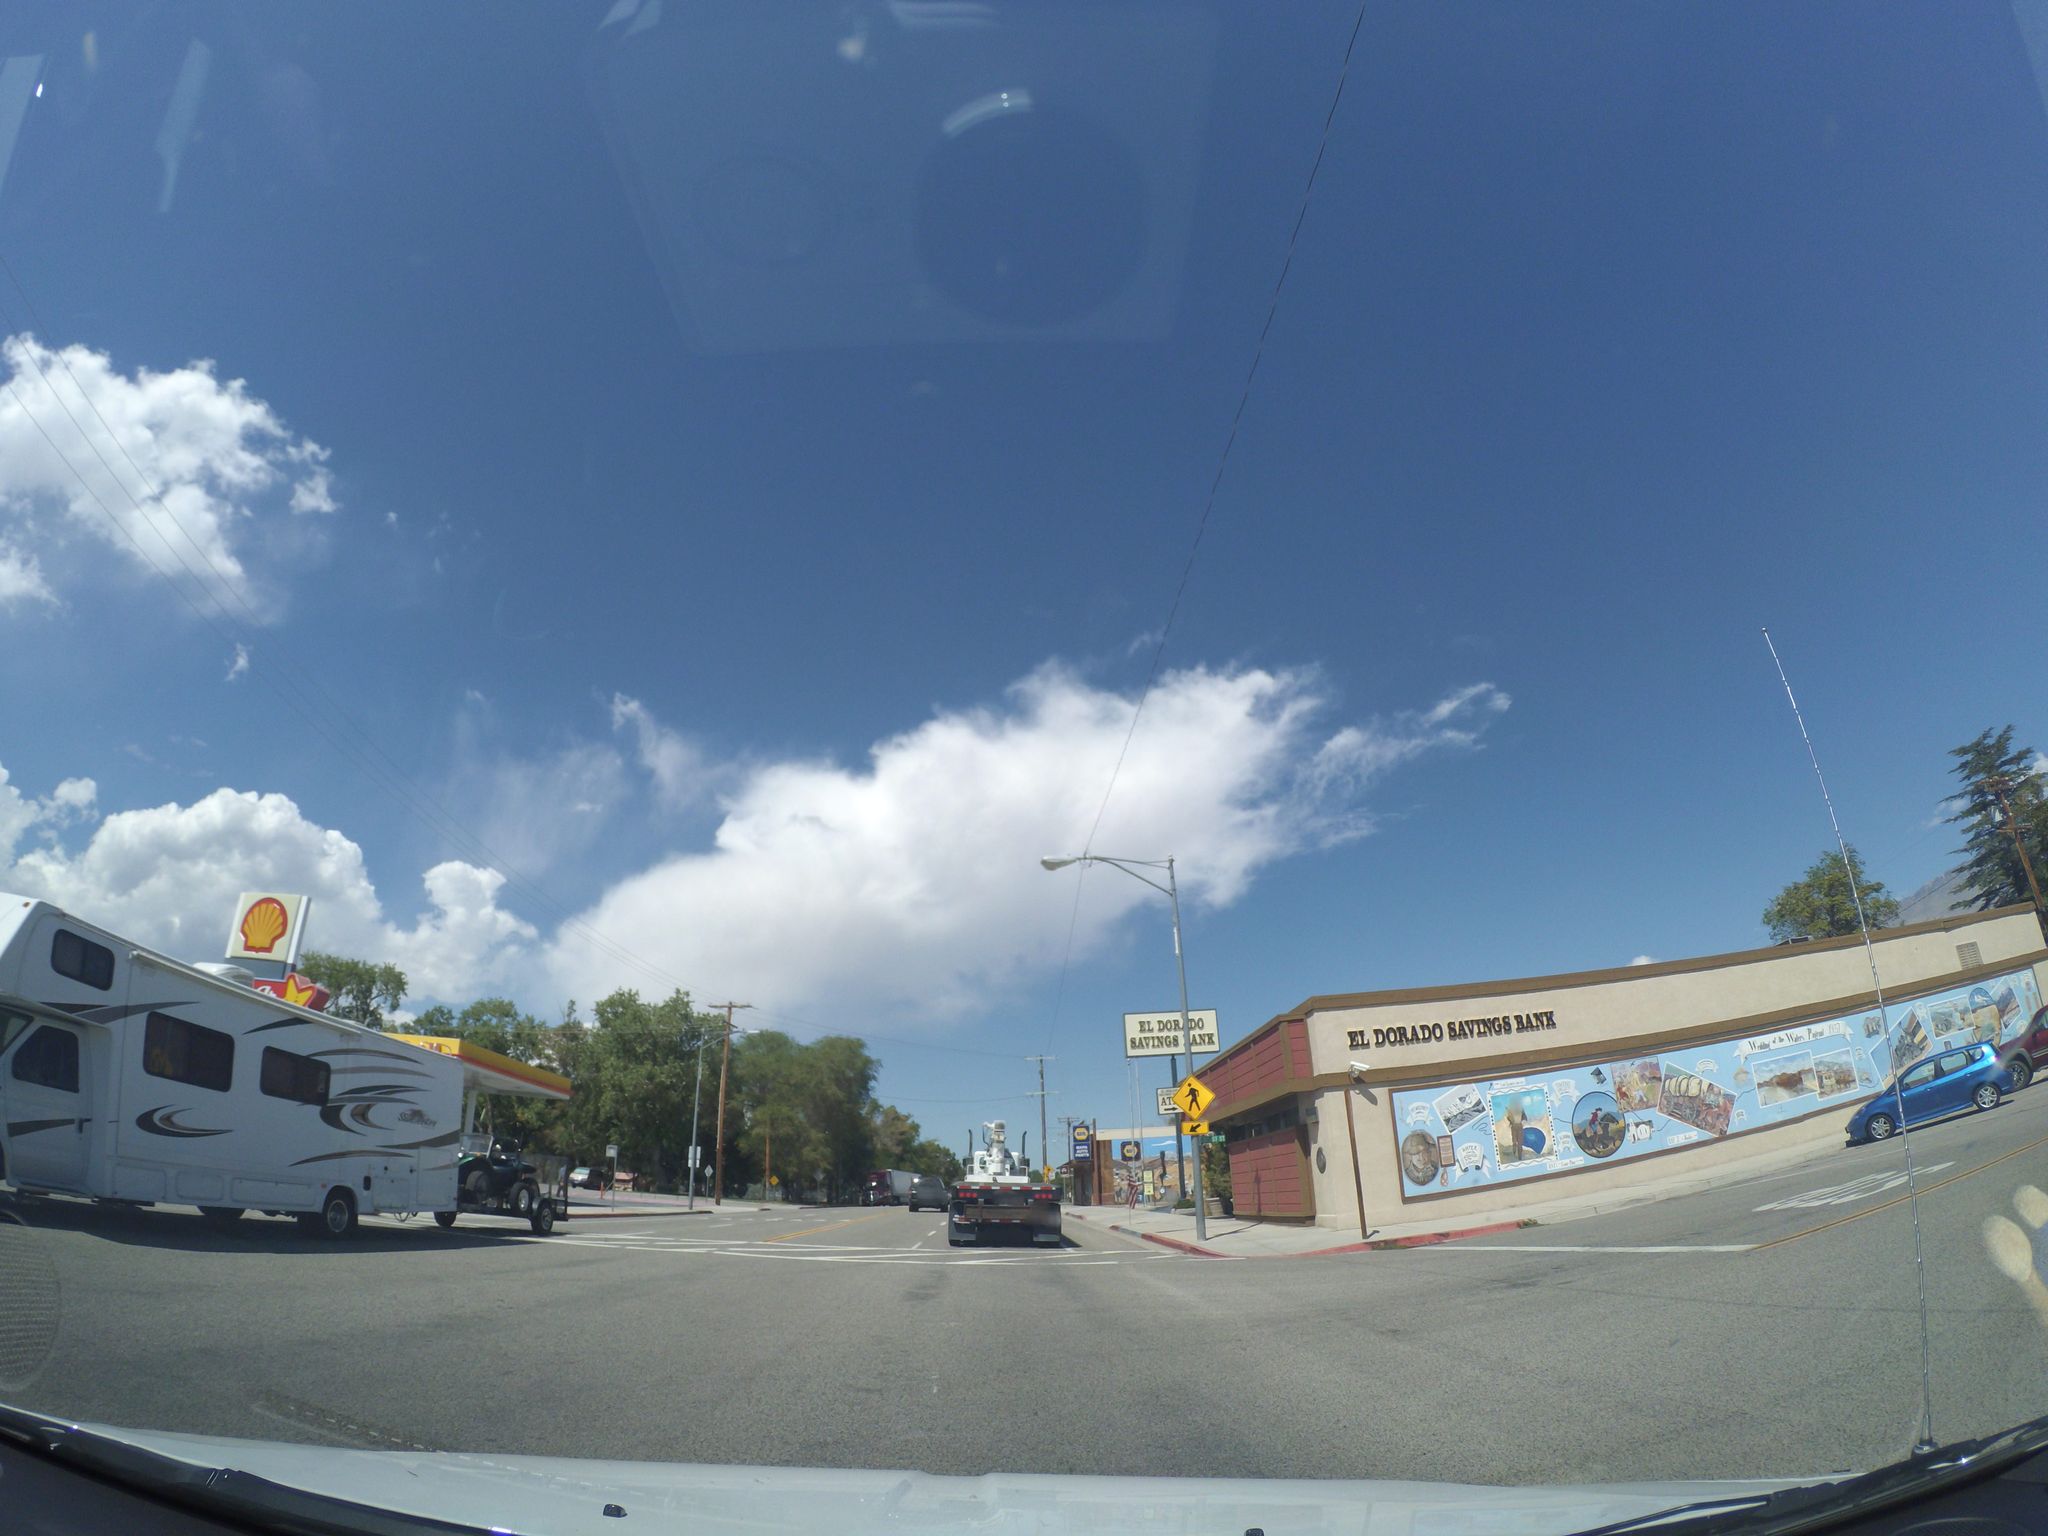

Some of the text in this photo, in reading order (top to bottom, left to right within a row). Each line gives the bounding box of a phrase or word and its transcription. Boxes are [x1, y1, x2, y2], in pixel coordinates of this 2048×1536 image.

[1138, 1020, 1154, 1033] EL
[1347, 1010, 1557, 1049] EL DORADO SAVINGS BANK
[1129, 1032, 1215, 1050] SAVINGS ANK
[1161, 1096, 1175, 1106] AT
